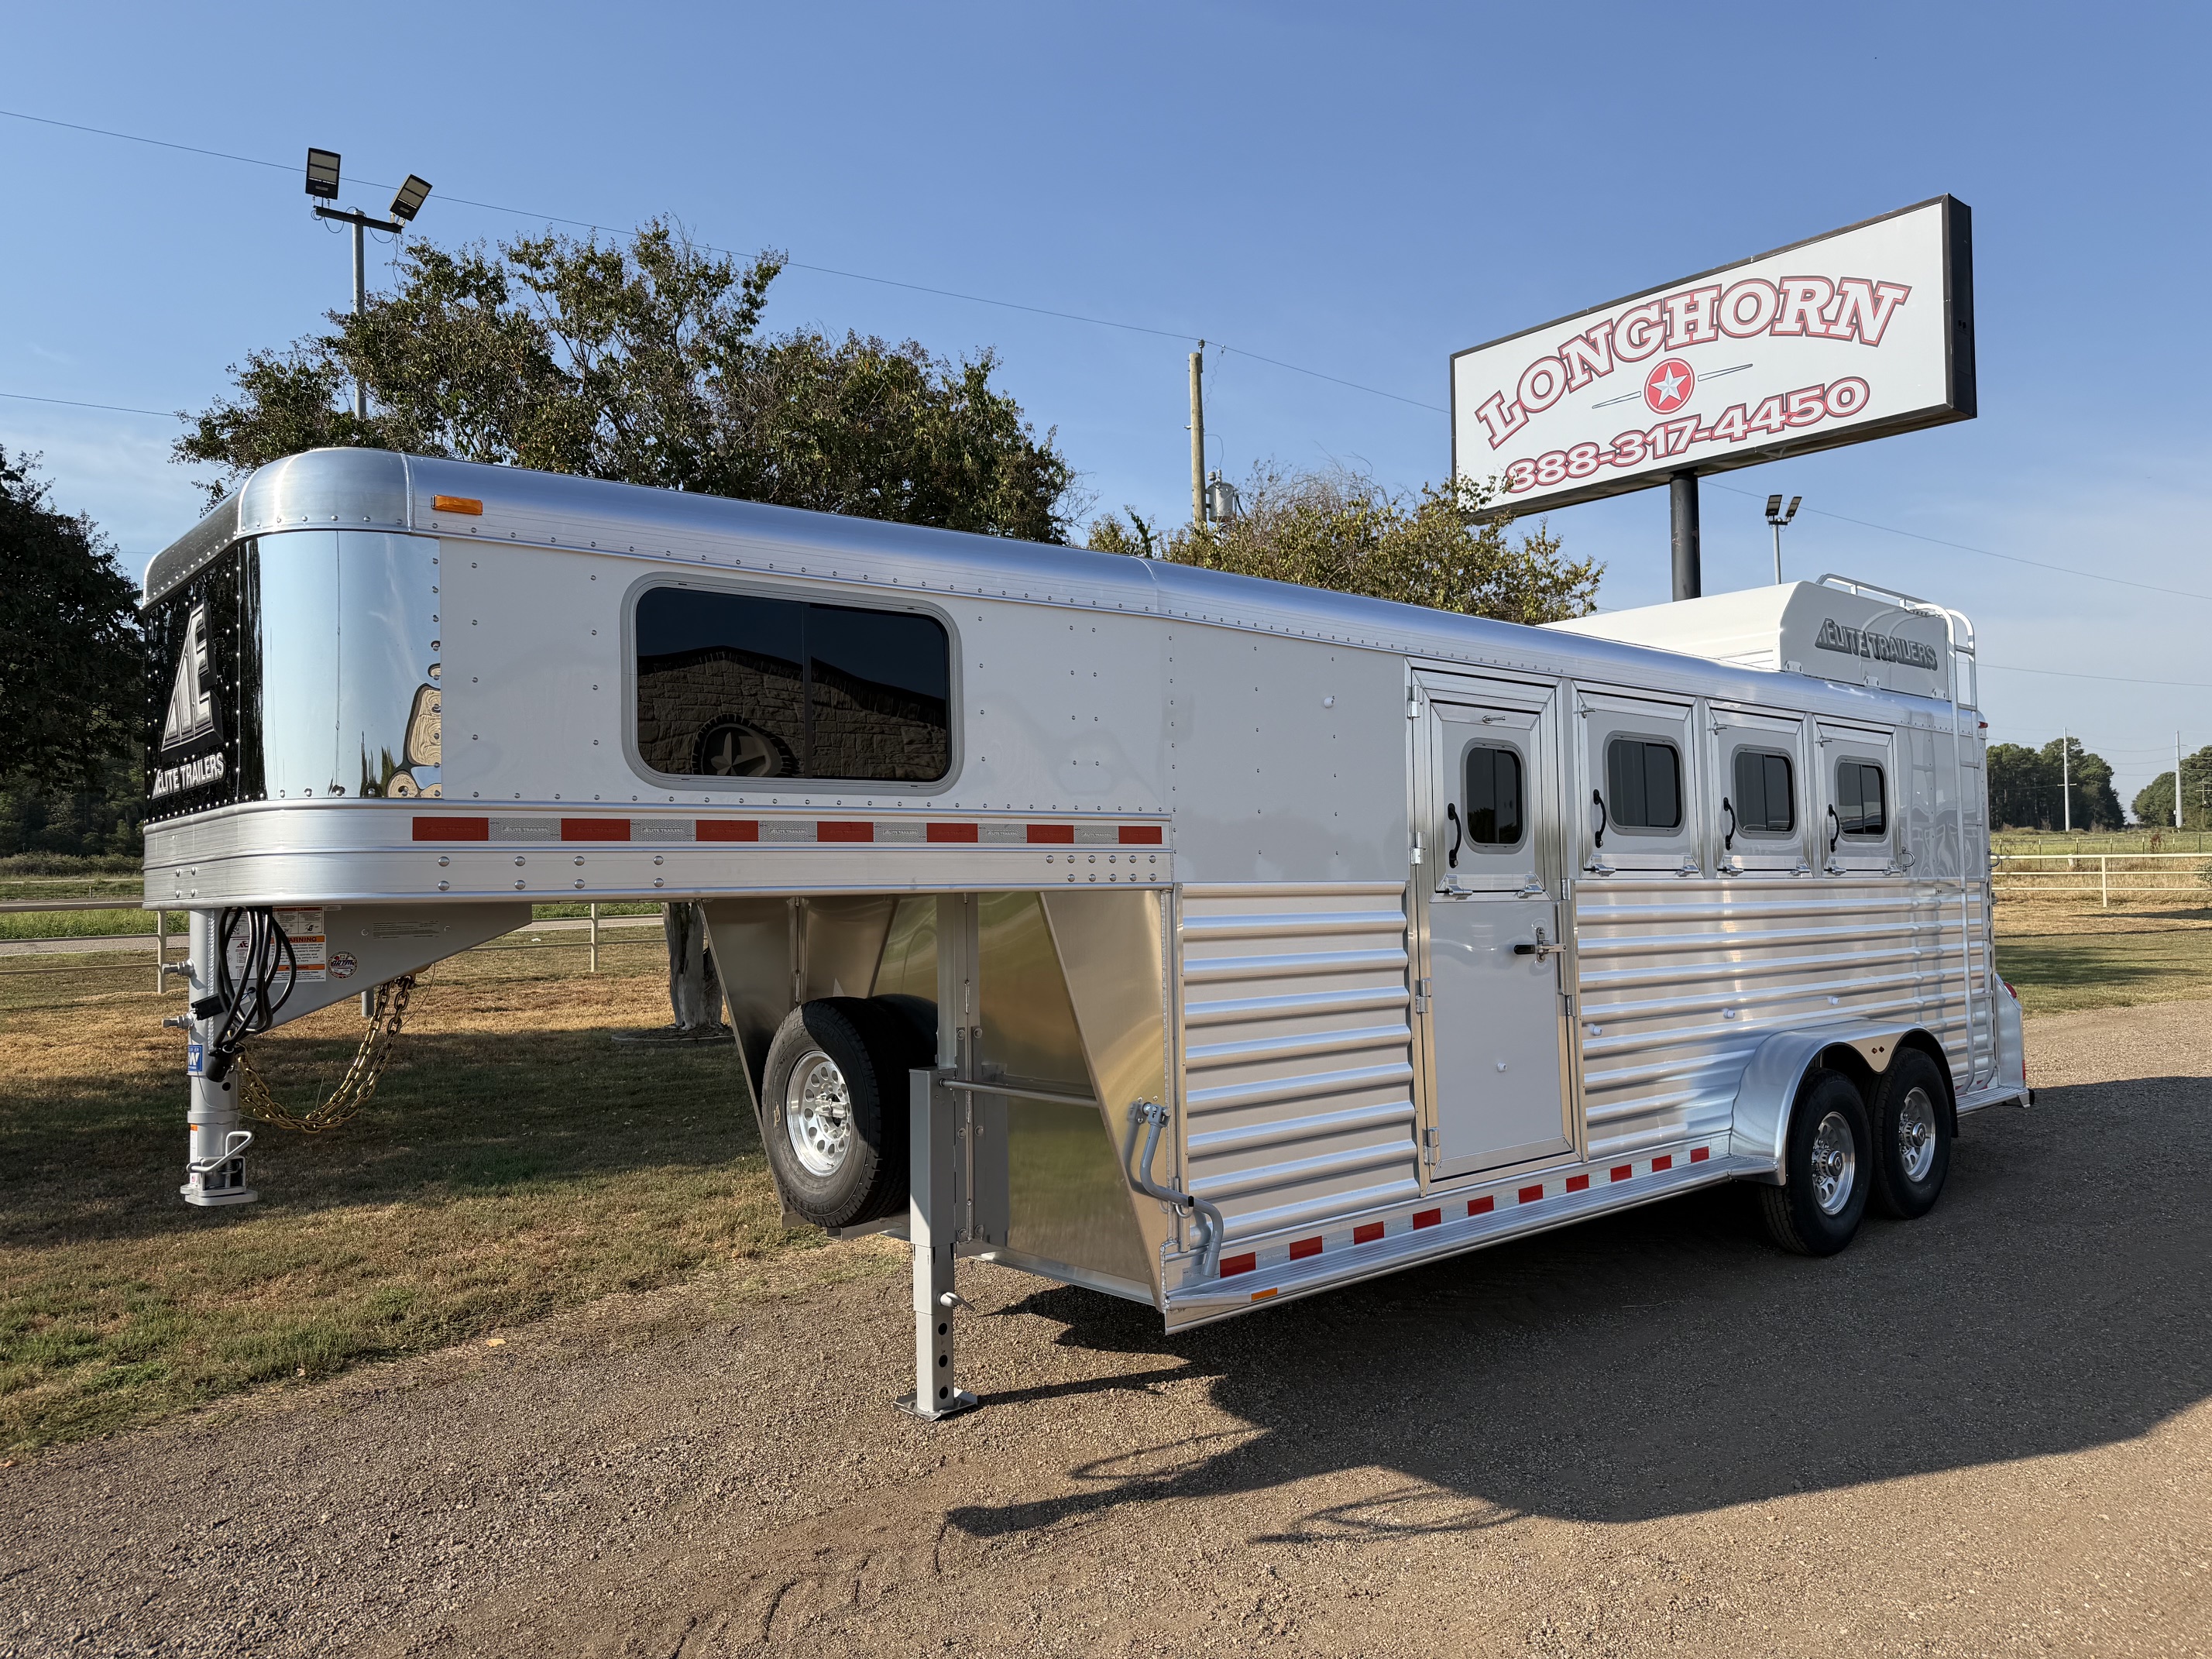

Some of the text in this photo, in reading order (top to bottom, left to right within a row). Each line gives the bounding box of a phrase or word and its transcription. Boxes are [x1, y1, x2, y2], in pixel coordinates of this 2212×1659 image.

[1475, 275, 1912, 451] LONGHORN
[1506, 376, 1870, 493] 888-317-4450
[1815, 618, 1938, 671] ELITE TRAILERS
[152, 752, 225, 799] ELITE TRAILERS
